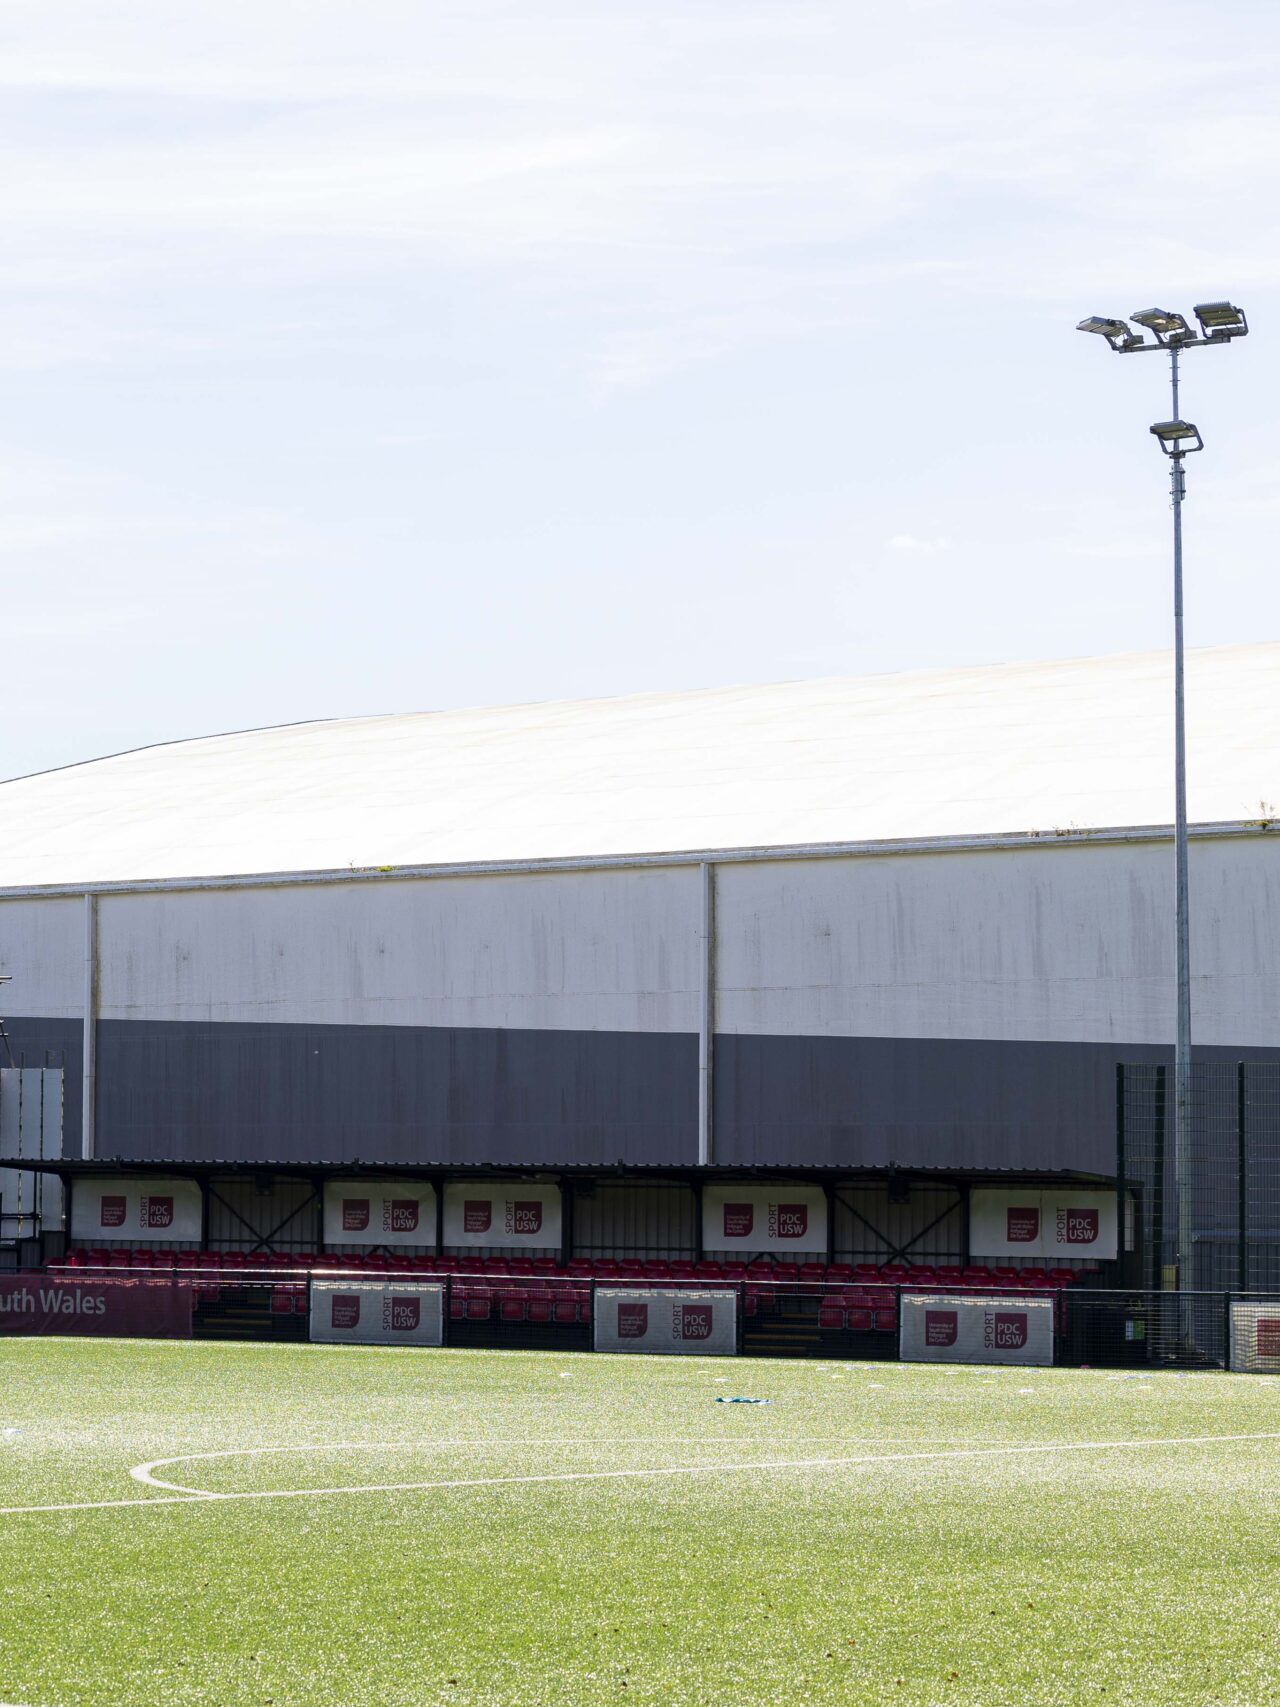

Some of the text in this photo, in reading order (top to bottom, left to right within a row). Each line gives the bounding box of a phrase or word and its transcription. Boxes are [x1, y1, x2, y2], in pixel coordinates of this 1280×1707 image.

[140, 1196, 148, 1229] SPORT
[150, 1206, 168, 1215] PDC
[394, 1209, 413, 1218] PDC
[516, 1211, 536, 1220] PDC
[150, 1215, 170, 1225] USW
[383, 1200, 391, 1232] SPORT
[505, 1200, 514, 1234] SPORT
[768, 1202, 776, 1238] SPORT
[780, 1214, 800, 1224] PDC
[394, 1219, 415, 1228] USW
[516, 1221, 538, 1230] USW
[1056, 1208, 1066, 1244] SPORT
[1070, 1219, 1092, 1229] PDC
[780, 1224, 804, 1234] USW
[1070, 1230, 1094, 1240] USW
[39, 1289, 106, 1315] Wales
[383, 1296, 391, 1331] SPORT
[394, 1307, 414, 1316] PDC
[394, 1317, 416, 1327] USW
[672, 1304, 681, 1340] SPORT
[684, 1315, 706, 1325] PDC
[684, 1326, 708, 1336] USW
[984, 1310, 993, 1349] SPORT
[998, 1323, 1020, 1334] PDC
[998, 1334, 1022, 1345] USW
